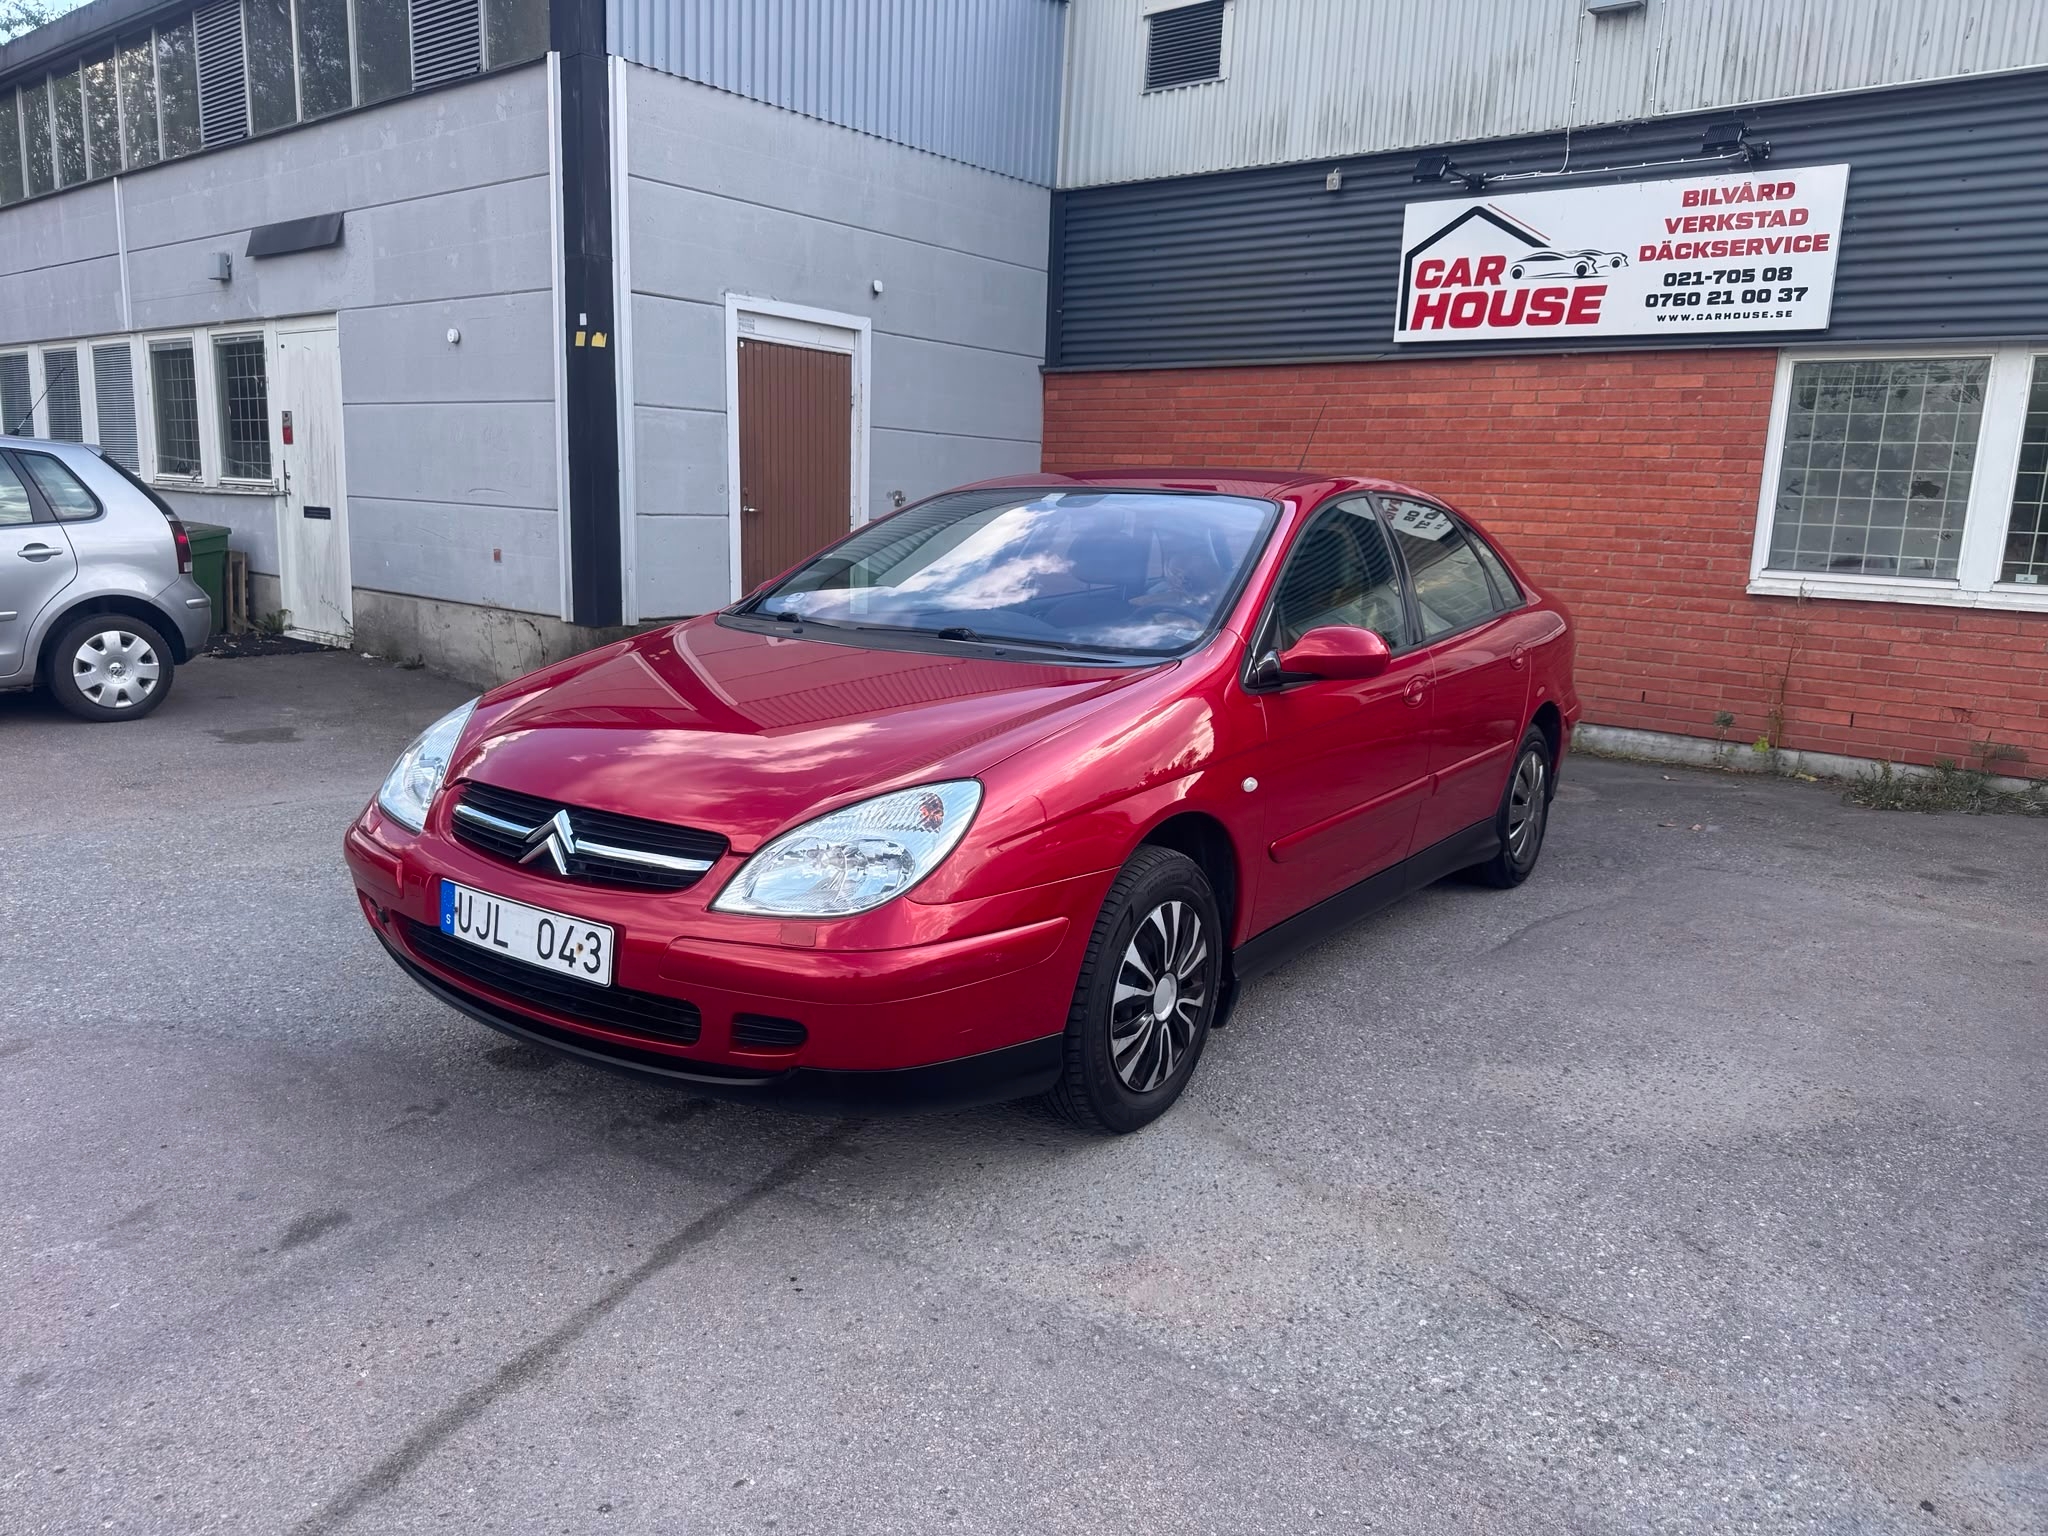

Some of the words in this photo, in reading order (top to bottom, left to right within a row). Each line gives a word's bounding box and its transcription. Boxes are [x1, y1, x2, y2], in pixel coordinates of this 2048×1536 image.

[1682, 182, 1796, 207] BILVÅRD
[1665, 208, 1809, 234] VERKSTAD
[1639, 234, 1830, 262] DÄCKSERVICE
[1415, 255, 1507, 290] CAR
[1663, 268, 1756, 287] 021-705
[1762, 266, 1793, 282] 08
[1410, 285, 1608, 331] HOUSE
[1645, 292, 1701, 308] 0760
[1706, 290, 1735, 306] 21
[1741, 288, 1772, 304] 00
[1777, 287, 1809, 302] 37
[1656, 310, 1793, 322] WWW.CARHOUSE.SE
[445, 913, 452, 925] S
[458, 891, 509, 949] UJL
[536, 918, 602, 975] 043
